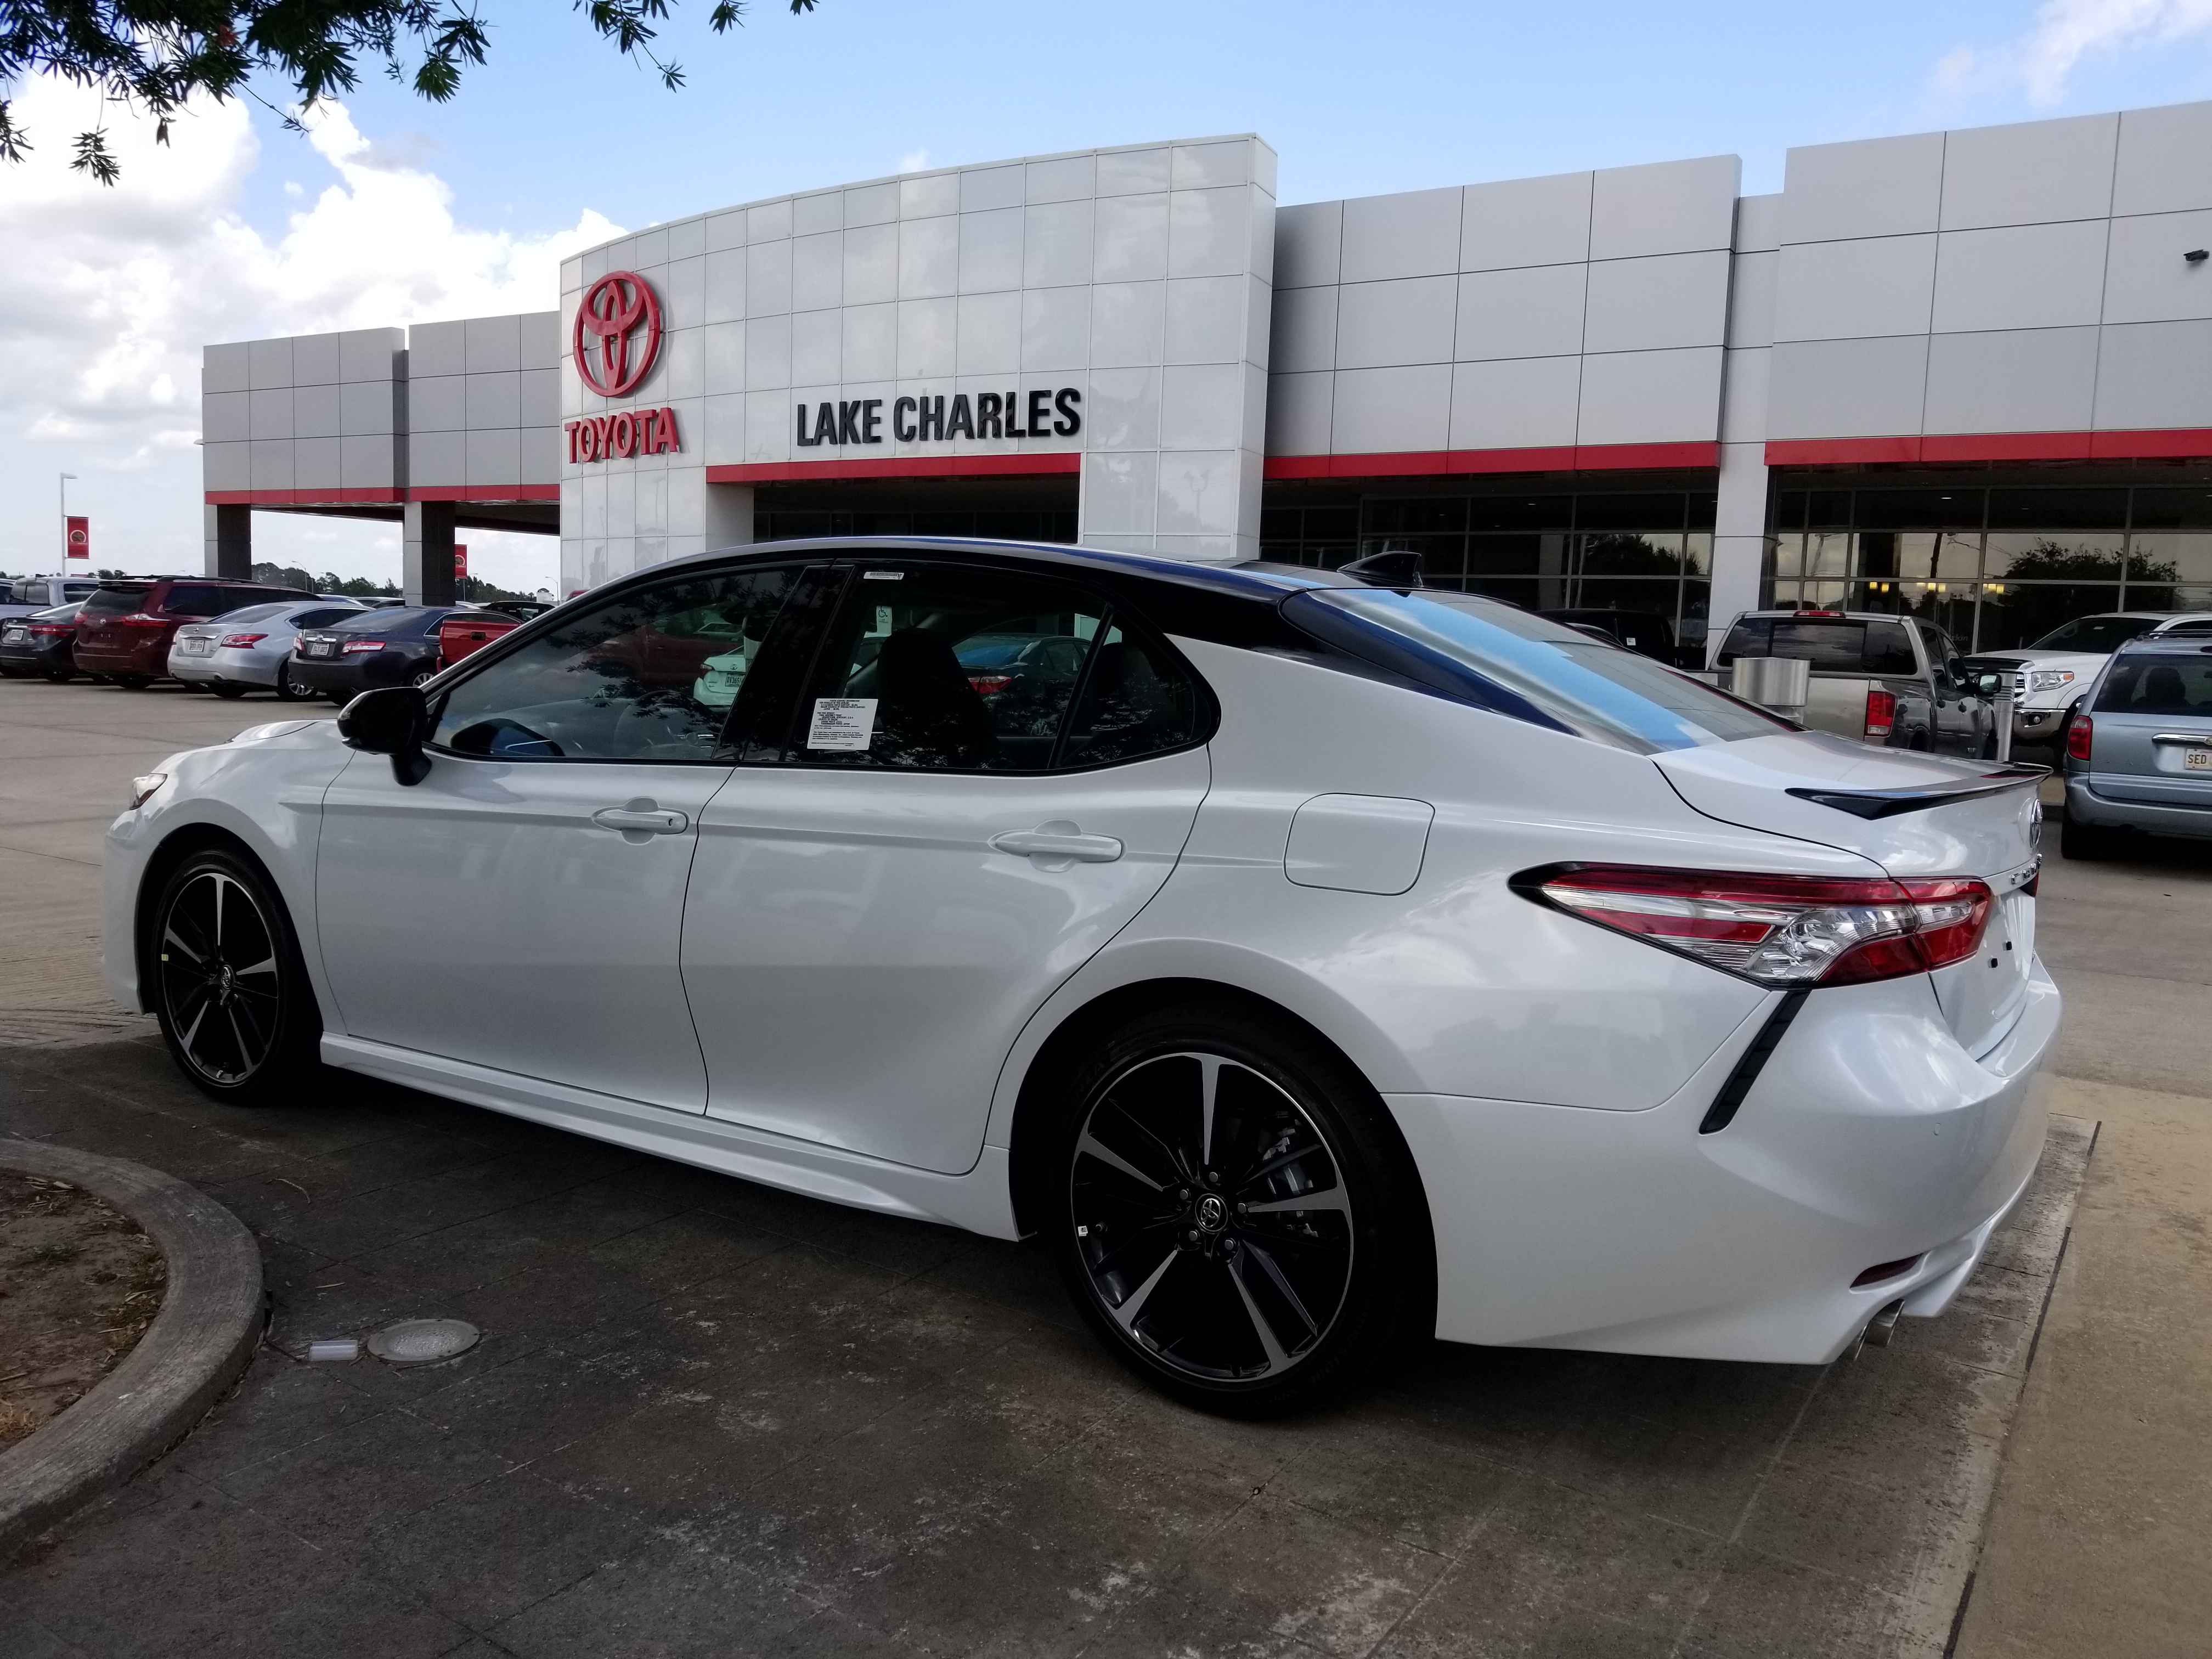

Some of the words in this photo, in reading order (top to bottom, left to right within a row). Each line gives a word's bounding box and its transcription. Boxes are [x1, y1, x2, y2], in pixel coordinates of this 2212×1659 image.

[565, 407, 680, 464] TOYOTA
[797, 399, 882, 446] LAKE
[893, 387, 1081, 442] CHARLES
[2188, 754, 2207, 764] SED
